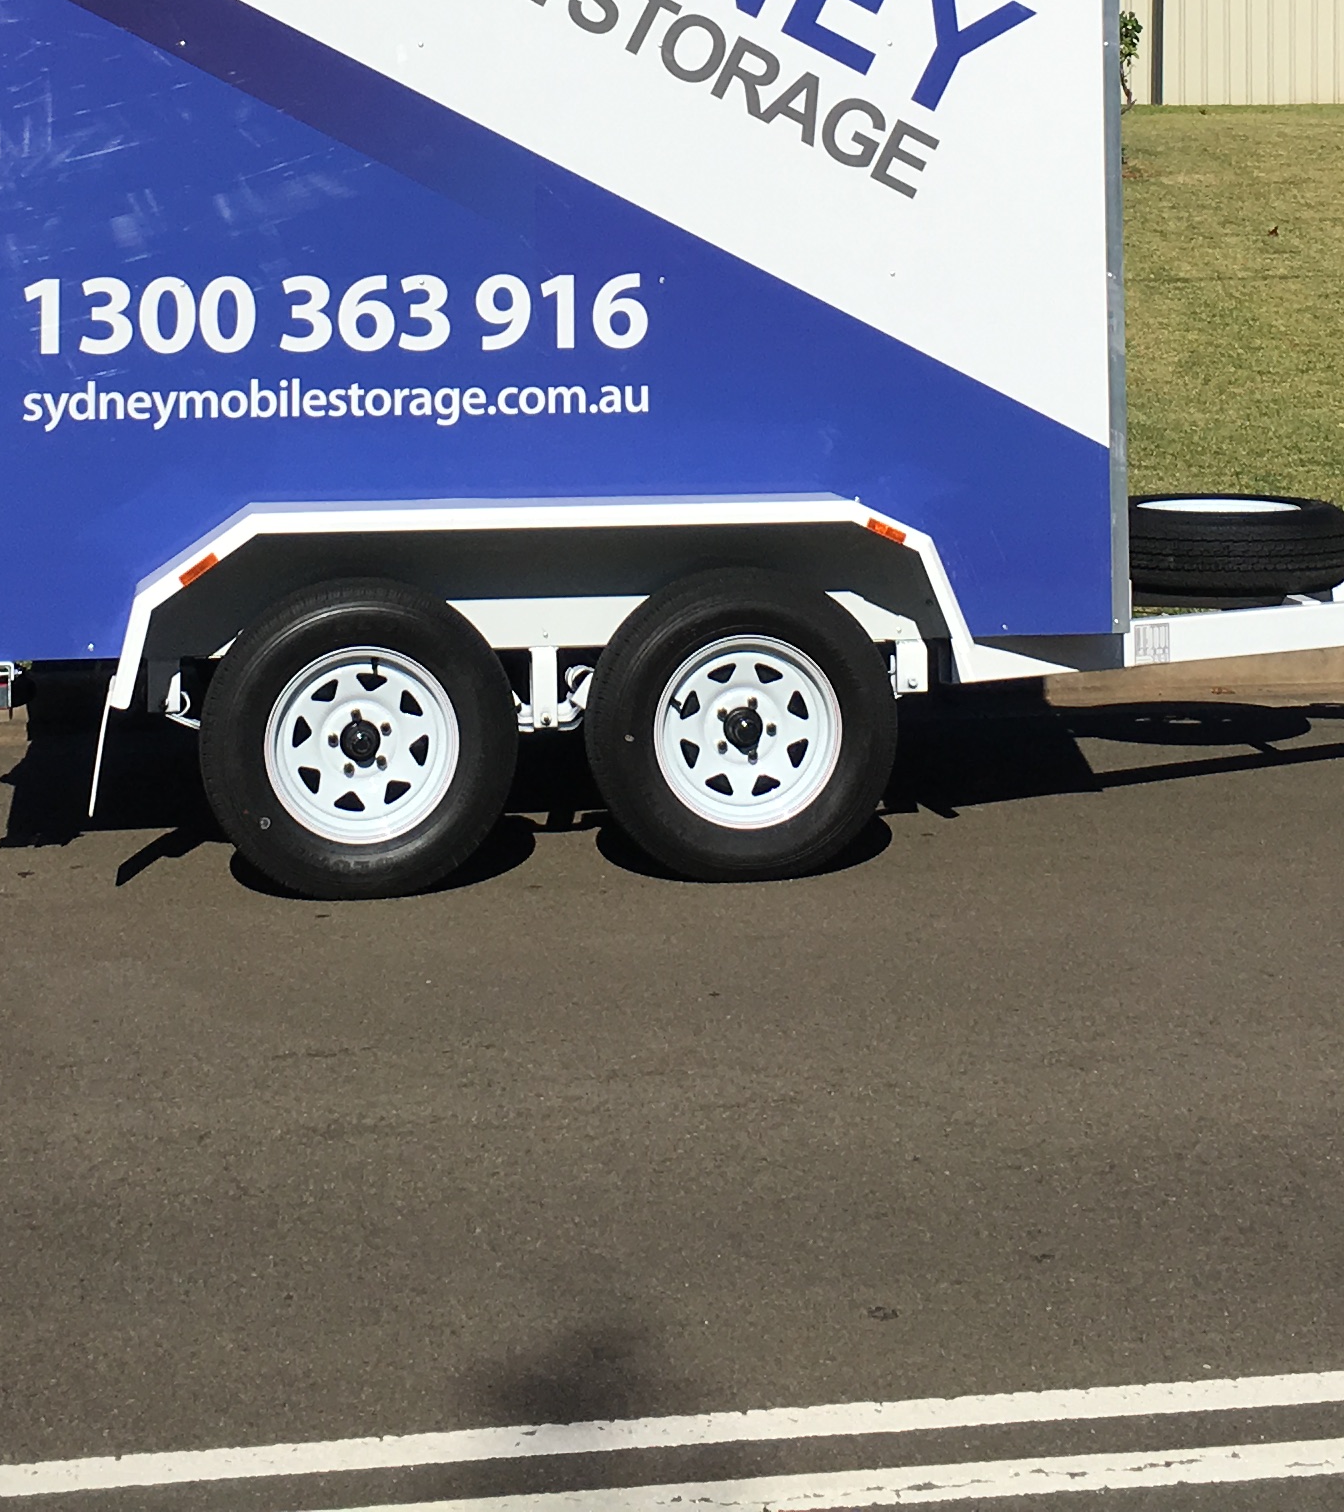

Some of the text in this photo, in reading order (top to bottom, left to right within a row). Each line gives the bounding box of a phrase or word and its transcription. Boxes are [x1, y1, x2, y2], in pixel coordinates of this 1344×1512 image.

[22, 272, 650, 356] 1300 363 916
[21, 377, 651, 434] sydneymobilestorage.com.au
